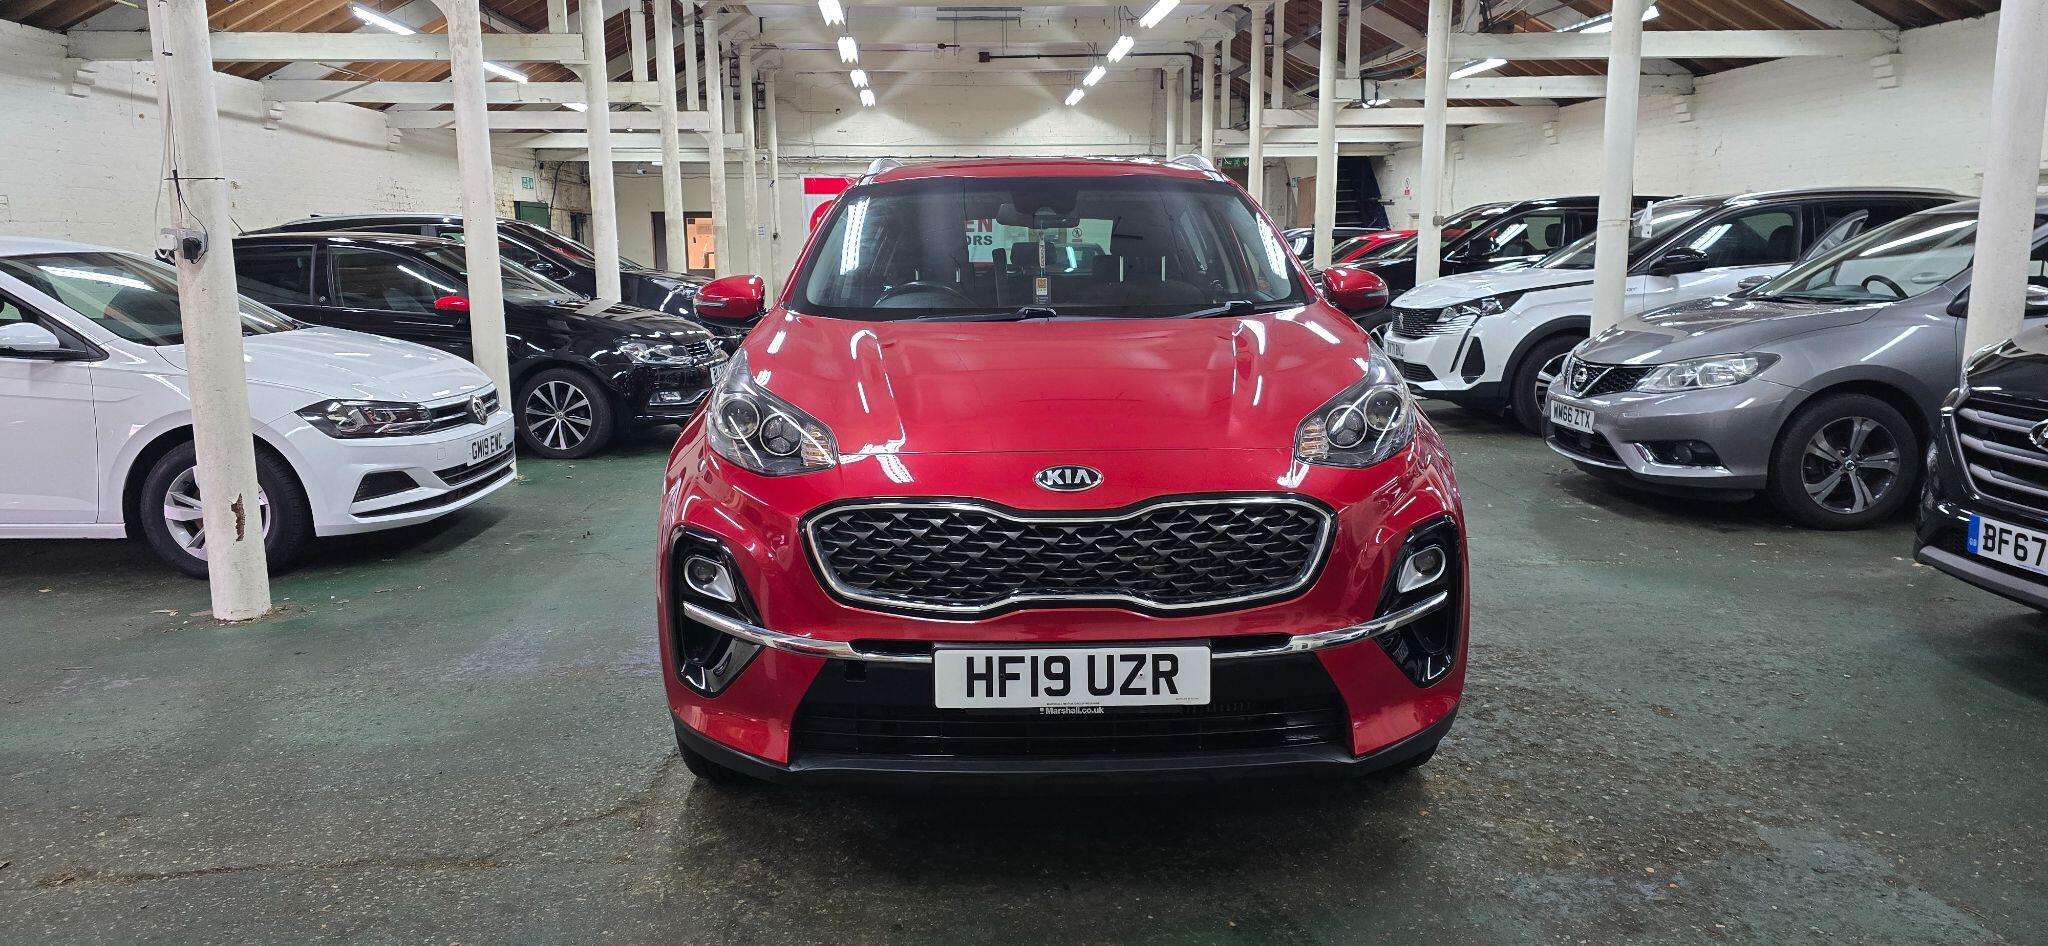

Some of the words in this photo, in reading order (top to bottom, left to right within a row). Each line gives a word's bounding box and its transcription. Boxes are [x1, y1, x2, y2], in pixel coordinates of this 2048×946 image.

[1574, 408, 1591, 429] ZTX
[1042, 469, 1092, 485] KIA
[1983, 523, 2047, 567] BF67
[966, 655, 1071, 698] HF19
[1087, 653, 1179, 696] UZR
[1045, 706, 1105, 715] Marshall.co.uk
